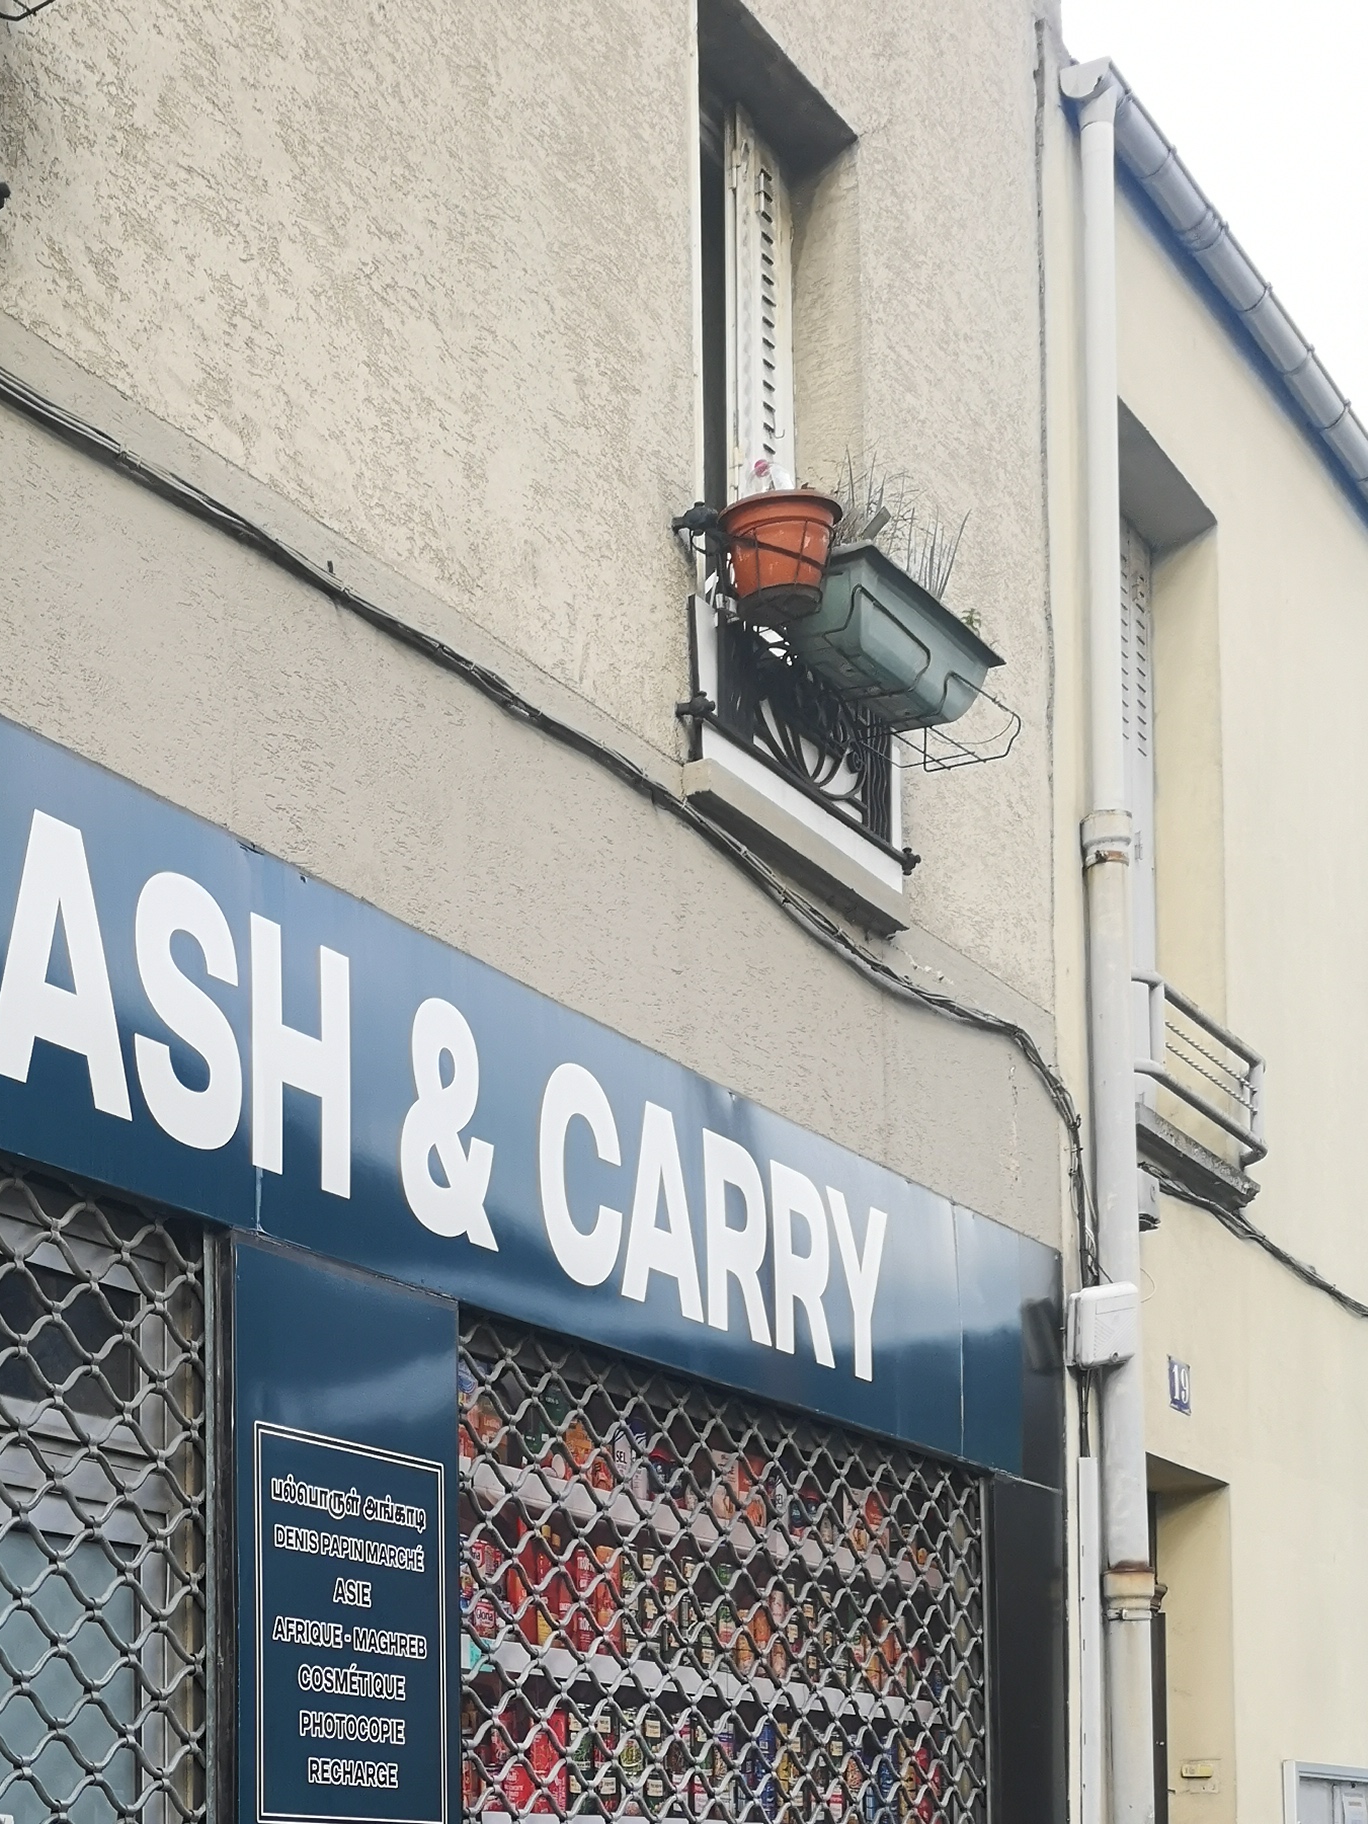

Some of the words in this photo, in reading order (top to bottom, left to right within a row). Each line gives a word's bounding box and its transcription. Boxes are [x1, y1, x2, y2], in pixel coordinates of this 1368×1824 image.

[400, 997, 499, 1252] &
[539, 1062, 888, 1382] CARRY
[1172, 1364, 1191, 1405] 19
[616, 1450, 628, 1465] SEL
[271, 1473, 361, 1520] பல்பொருள்
[363, 1494, 427, 1534] அங்காடி
[274, 1523, 318, 1555] DENIS
[320, 1532, 365, 1562] PAPIN
[365, 1540, 425, 1573] MARCHÉ
[333, 1577, 372, 1608] ASIE
[272, 1616, 343, 1649] AFRIQUE
[353, 1627, 427, 1660] MAGHREB
[297, 1663, 406, 1701] COSMÉTIQUE
[299, 1710, 405, 1745] PHOTOCOPIE
[308, 1757, 399, 1788] RECHARGE
